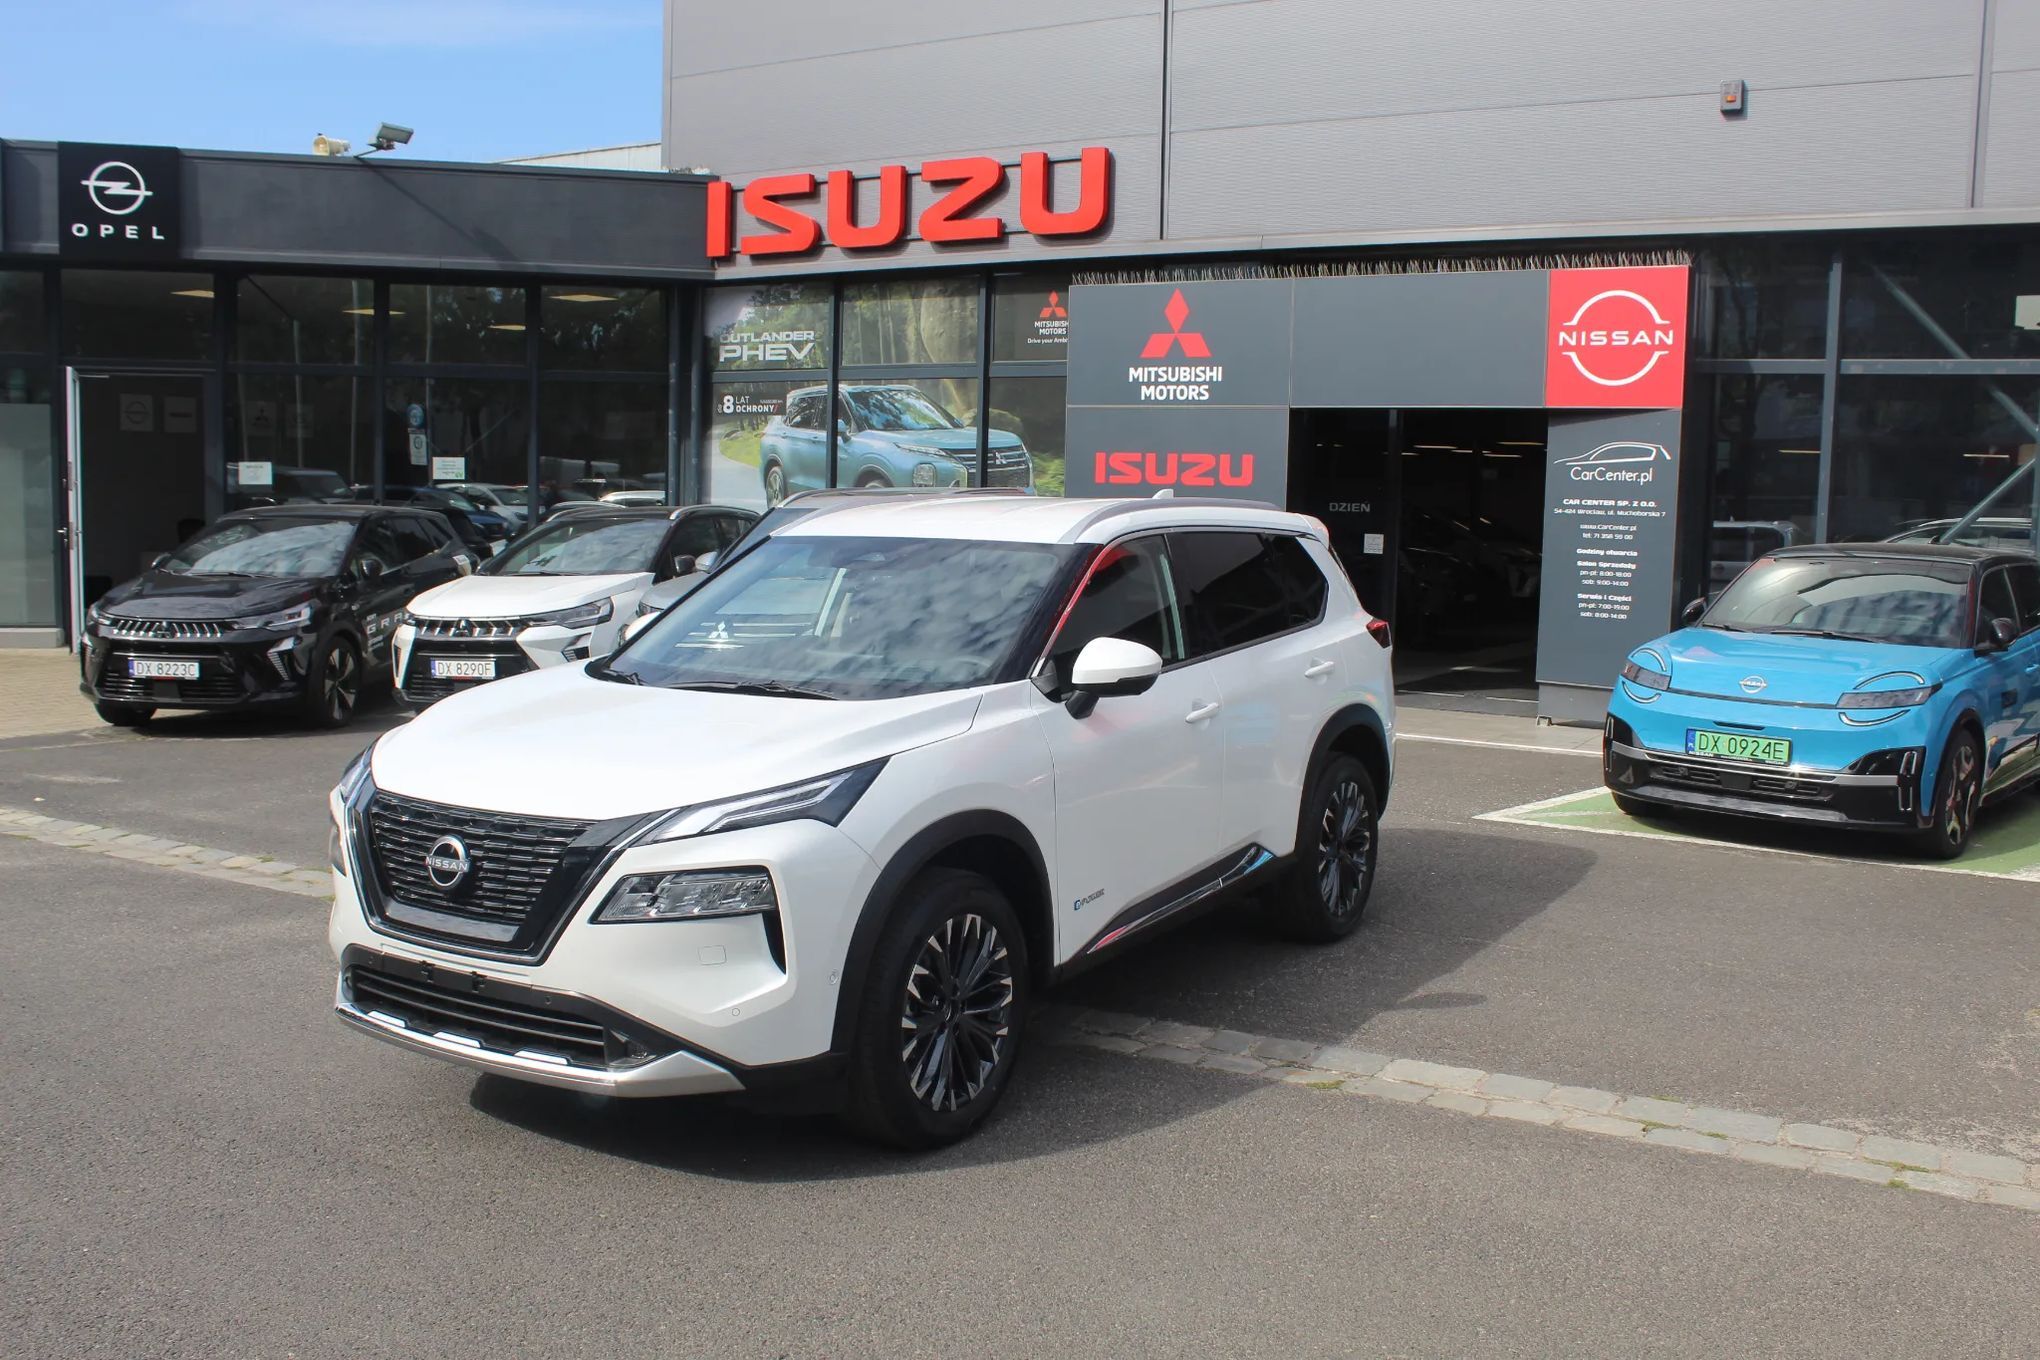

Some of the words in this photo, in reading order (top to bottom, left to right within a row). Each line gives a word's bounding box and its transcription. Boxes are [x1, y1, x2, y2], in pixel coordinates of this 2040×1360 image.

[706, 147, 1109, 258] ISUZU
[71, 223, 165, 240] OPEL
[1034, 320, 1070, 328] MITSUBISH
[720, 331, 815, 343] OUTLANDER
[1559, 330, 1674, 346] NISSAN
[719, 343, 815, 362] PHEV
[1128, 366, 1223, 383] MITSUBISHI
[1141, 384, 1210, 401] MOTORS
[723, 395, 734, 414] 8
[736, 396, 750, 404] LAT
[735, 405, 774, 413] OCHRONY
[1095, 452, 1254, 487] ISUZU
[1570, 467, 1653, 486] CarCenter.pl
[1563, 498, 1580, 506] CAR
[1581, 499, 1615, 507] CENTER
[1576, 548, 1605, 556] Godziny
[1606, 549, 1638, 557] otwarcia
[136, 662, 152, 675] DX
[157, 663, 195, 676] 8223C
[437, 662, 452, 675] DX
[456, 663, 491, 676] 8290F
[1699, 733, 1720, 752] DX
[1728, 737, 1784, 760] 0924E
[425, 856, 468, 871] NISSAN
